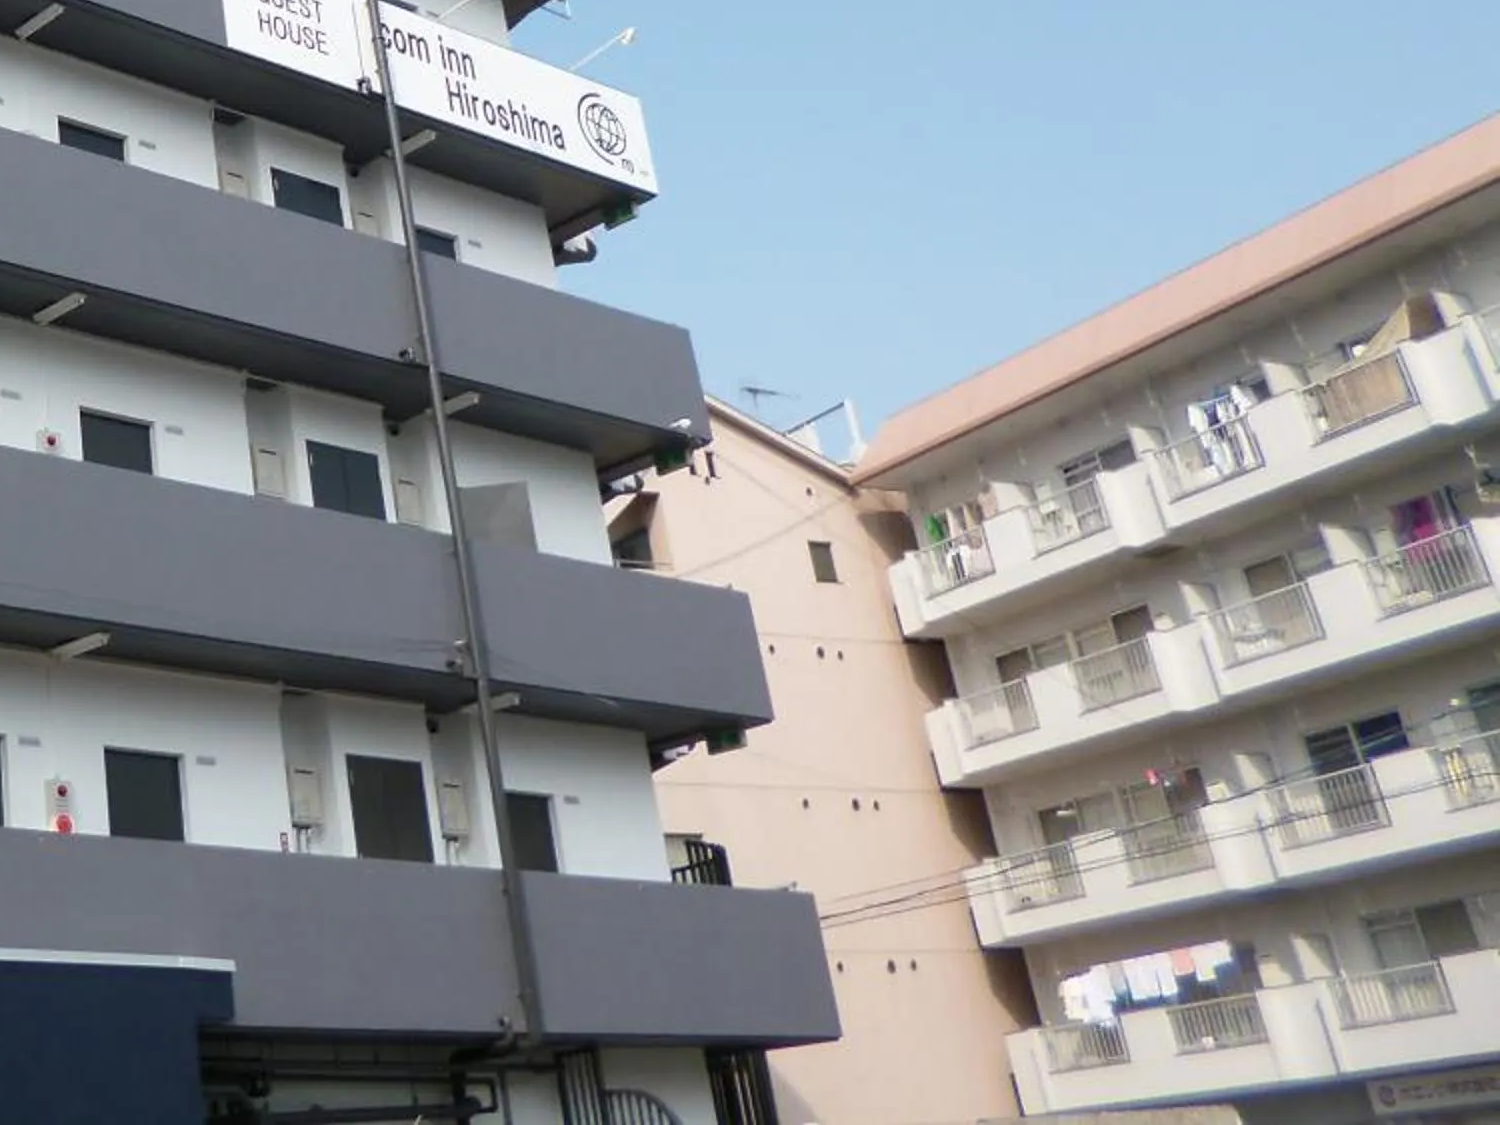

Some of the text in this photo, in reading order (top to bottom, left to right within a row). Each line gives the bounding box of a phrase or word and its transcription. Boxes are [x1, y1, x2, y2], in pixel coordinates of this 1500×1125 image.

[256, 9, 330, 56] HOUSE
[437, 34, 477, 80] inn
[444, 77, 566, 151] Hiroshima
